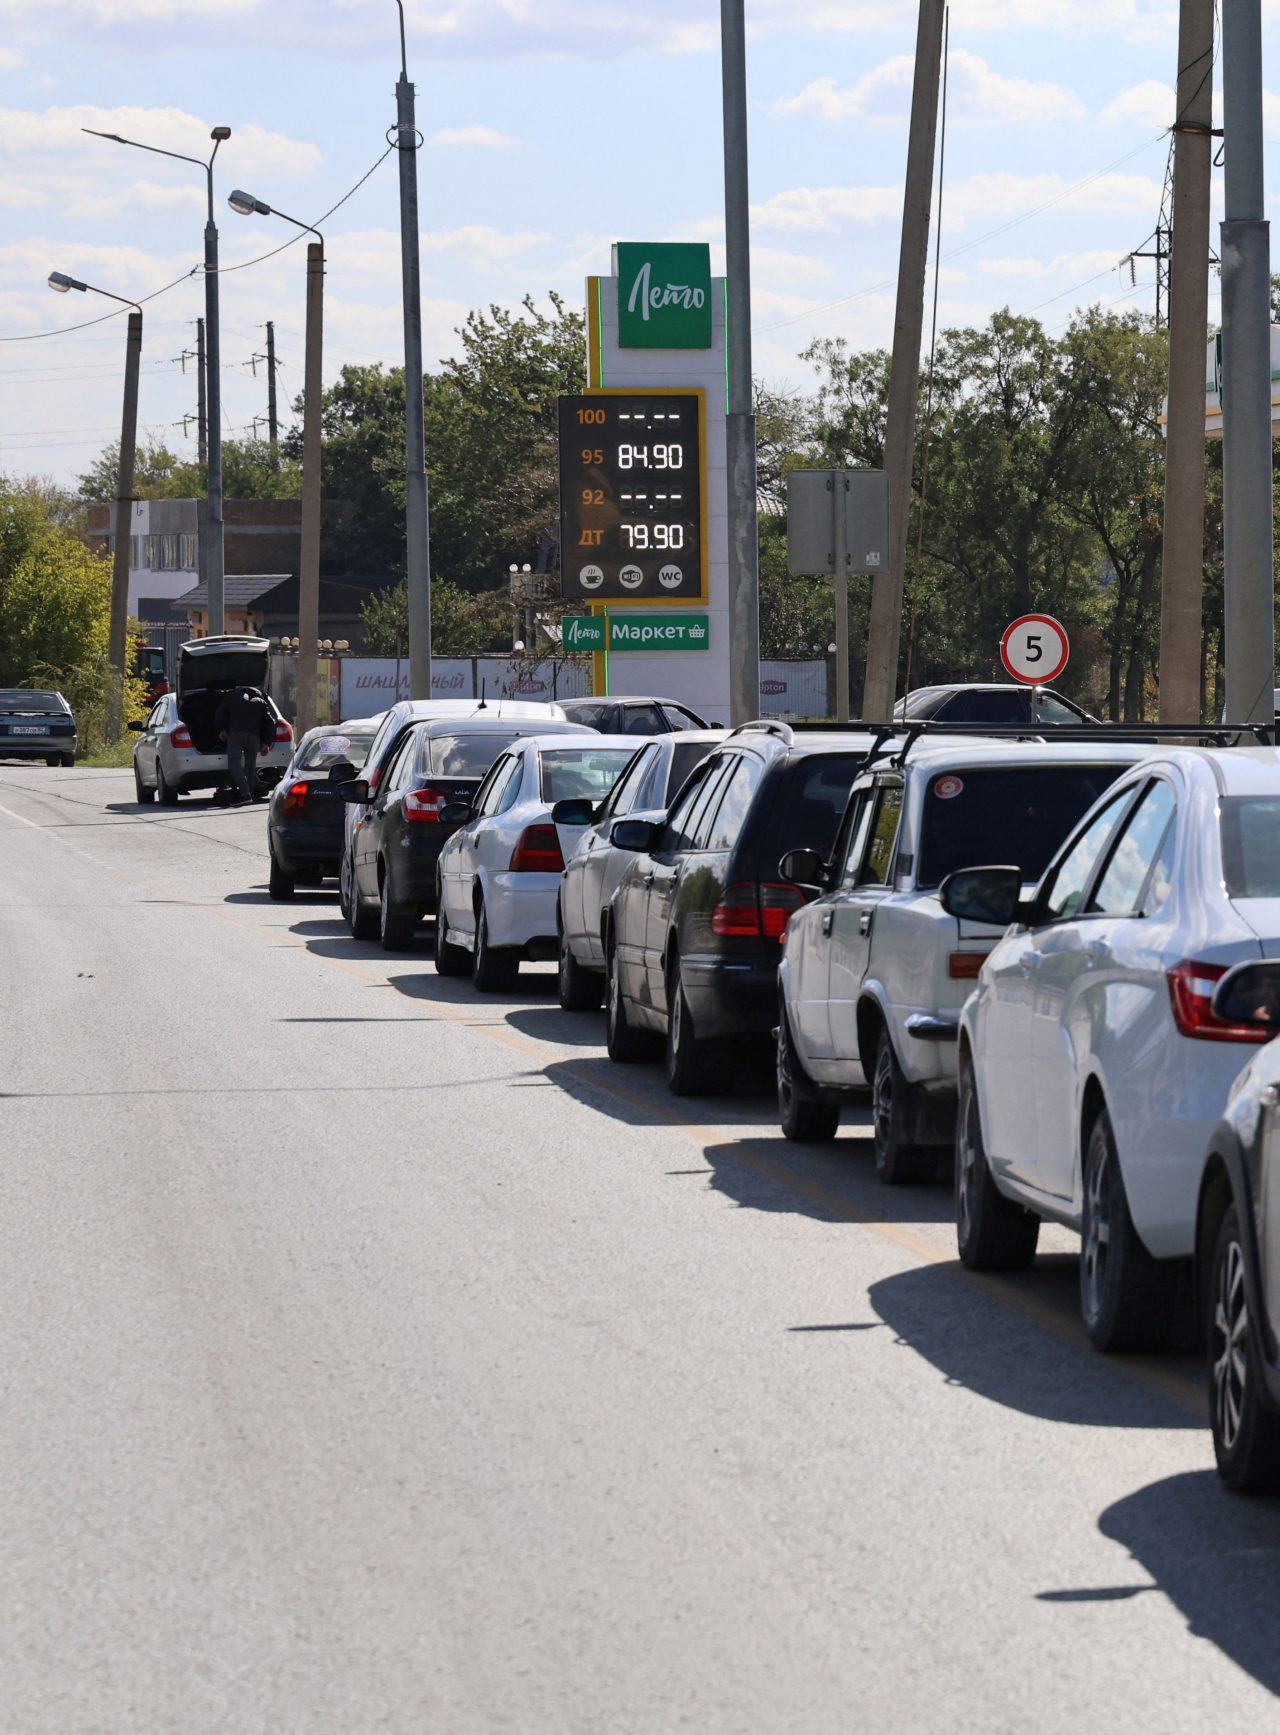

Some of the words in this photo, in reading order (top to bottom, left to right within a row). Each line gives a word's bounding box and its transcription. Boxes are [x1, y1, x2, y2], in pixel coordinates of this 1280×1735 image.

[627, 262, 705, 321] Лето
[576, 409, 606, 425] 100
[581, 450, 604, 465] 95
[618, 444, 683, 469] 84.90
[582, 490, 604, 505] 92
[578, 530, 604, 546] ДТ
[620, 525, 684, 549] 79.90
[661, 572, 681, 581] WC
[568, 620, 601, 644] Лето
[612, 624, 686, 642] Маркет
[1025, 635, 1043, 662] 5
[355, 673, 465, 689] ШАШЛНЫЙ
